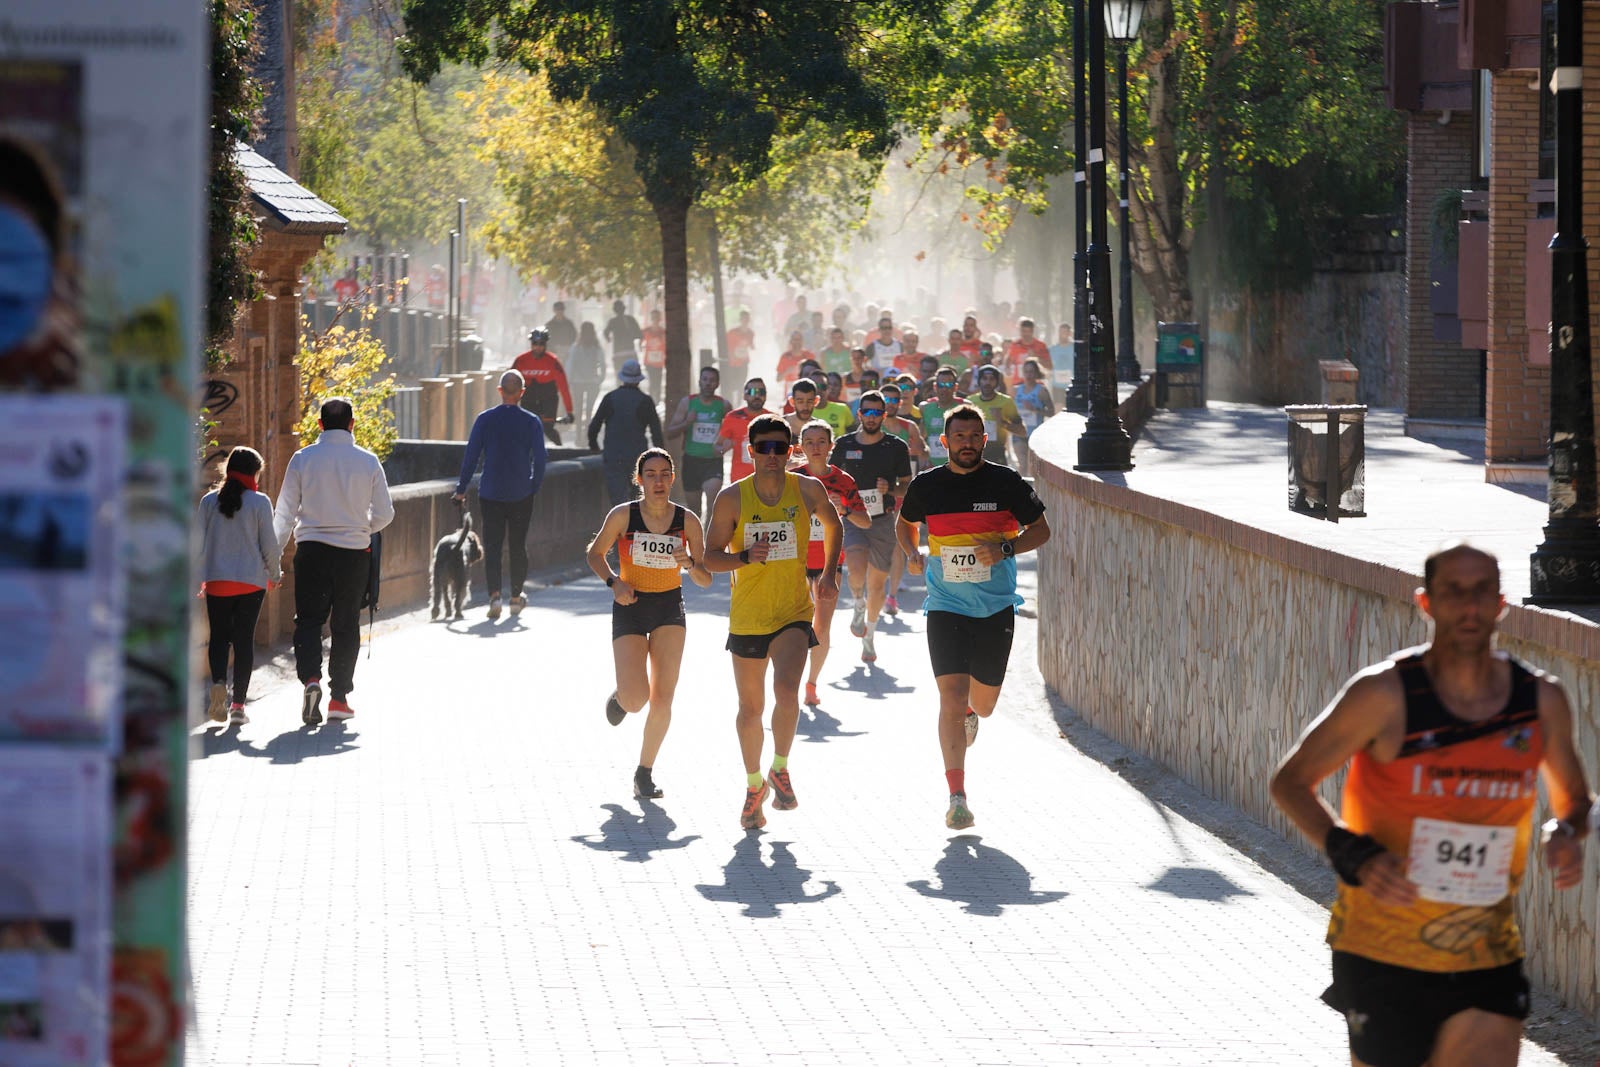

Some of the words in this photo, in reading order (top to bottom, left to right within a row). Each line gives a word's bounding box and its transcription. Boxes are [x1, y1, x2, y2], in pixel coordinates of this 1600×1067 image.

[641, 540, 674, 555] 1030
[951, 553, 976, 566] 470
[1436, 838, 1488, 868] 941
